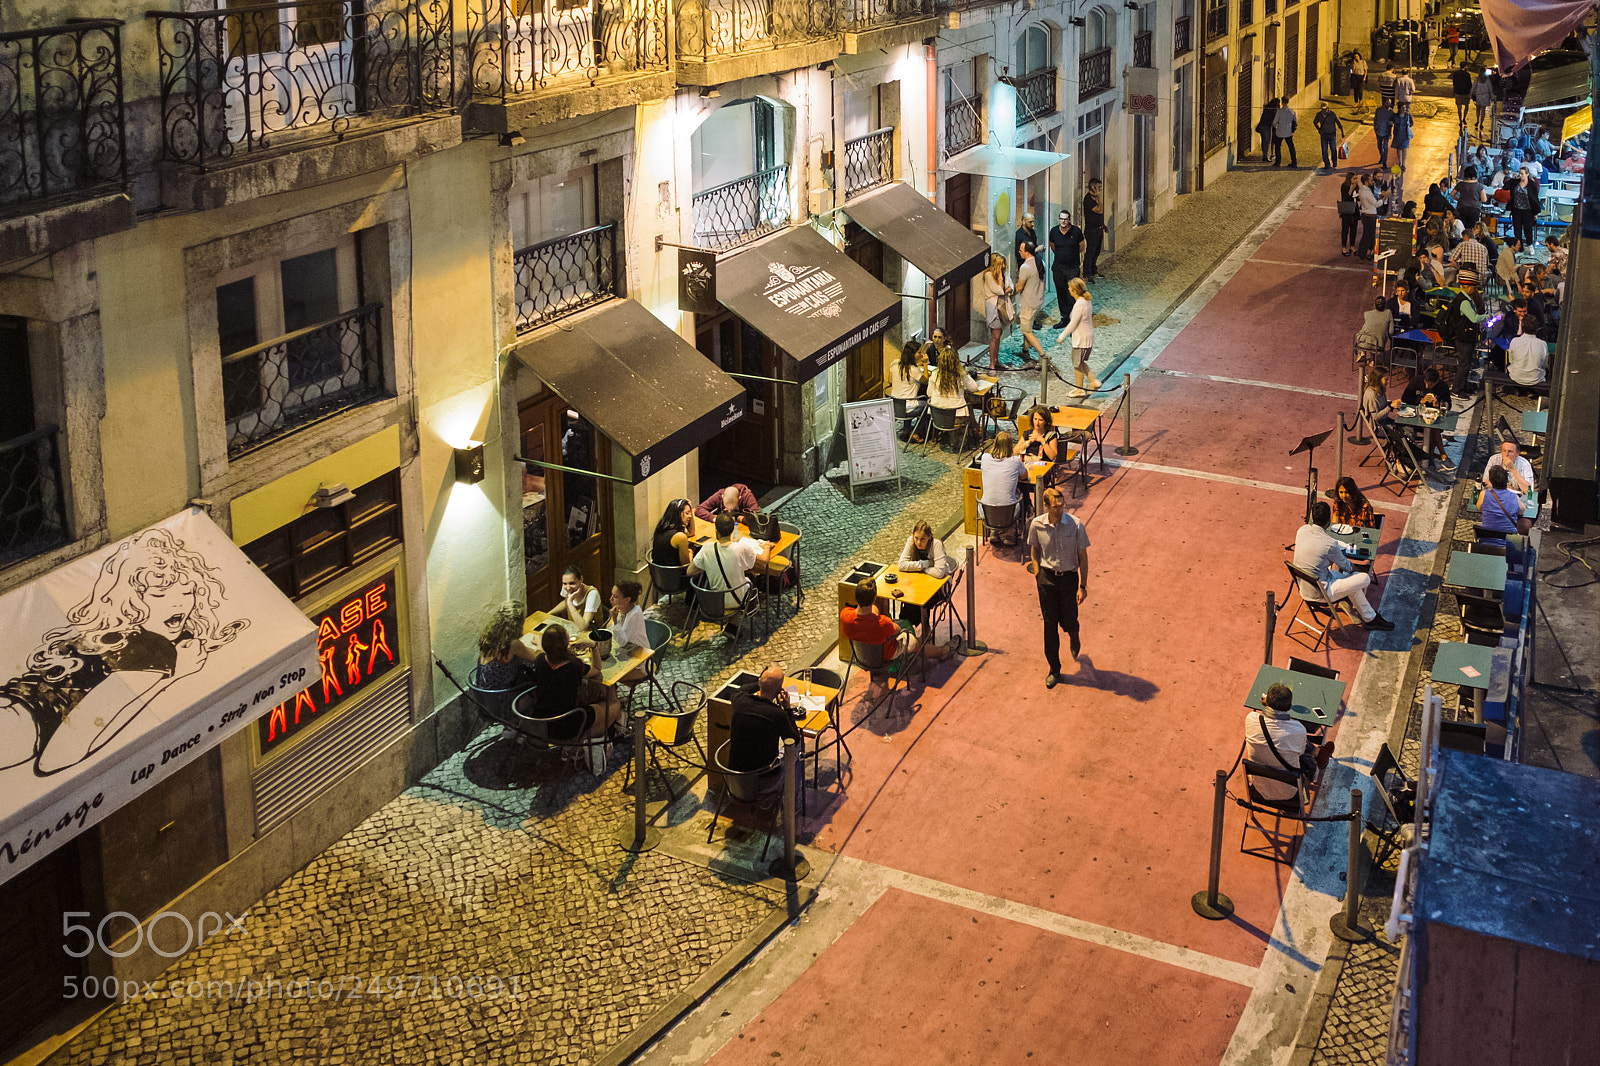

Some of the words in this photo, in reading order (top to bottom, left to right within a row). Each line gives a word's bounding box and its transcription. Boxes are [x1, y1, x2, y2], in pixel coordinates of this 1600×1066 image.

[767, 270, 836, 308] ESPUMANTARIA
[803, 290, 830, 308] CAIS
[827, 331, 862, 361] ESPUMANTARIA
[862, 327, 869, 339] DO
[869, 321, 880, 335] CAIS
[130, 763, 154, 785] Lap
[160, 733, 201, 766] Dance
[219, 702, 248, 728] Strip
[252, 684, 275, 706] Non
[279, 667, 307, 690] Stop
